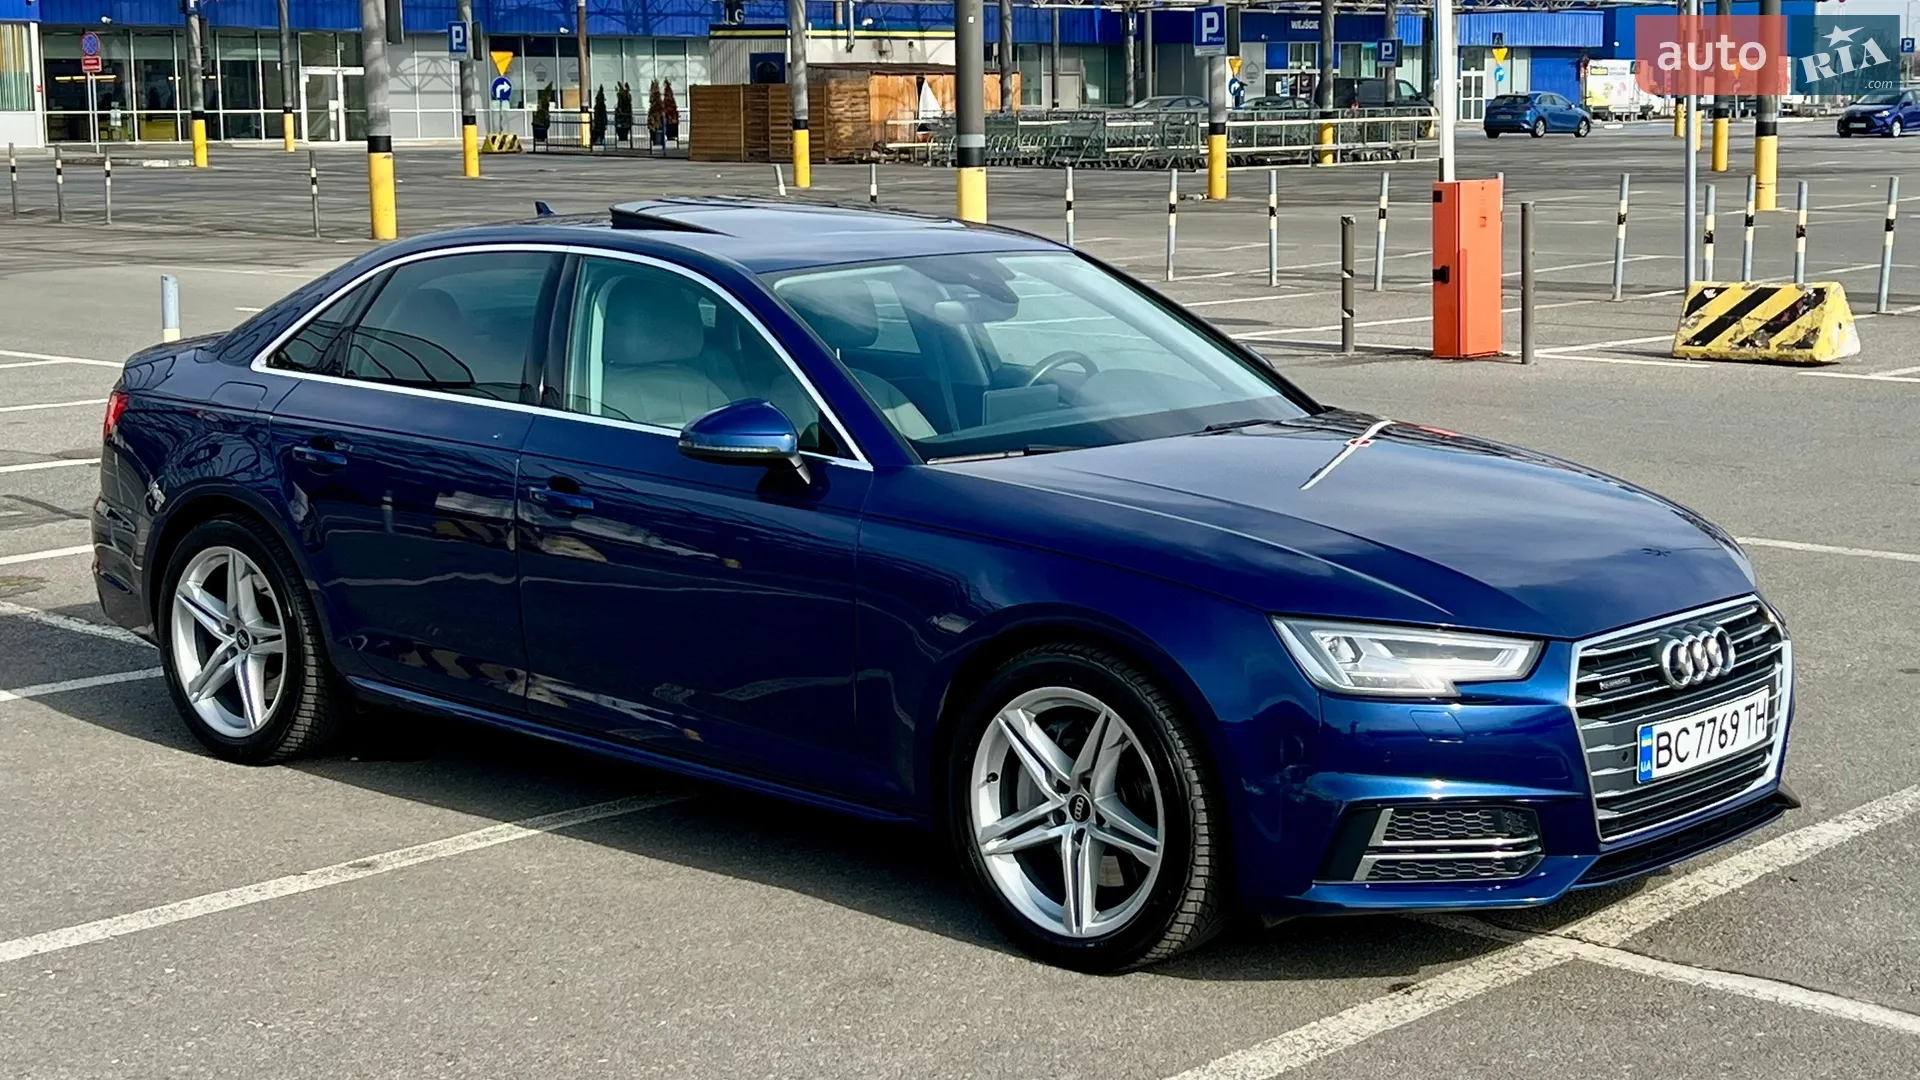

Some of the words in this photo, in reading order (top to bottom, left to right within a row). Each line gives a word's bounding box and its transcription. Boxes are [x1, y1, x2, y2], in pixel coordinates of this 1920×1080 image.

[452, 25, 464, 50] P
[1201, 12, 1219, 42] P
[1381, 42, 1393, 60] P
[1903, 39, 1913, 52] P
[1655, 726, 1691, 770] BC
[1695, 709, 1740, 759] 7769
[1744, 698, 1767, 739] TH
[1640, 759, 1652, 773] UA
